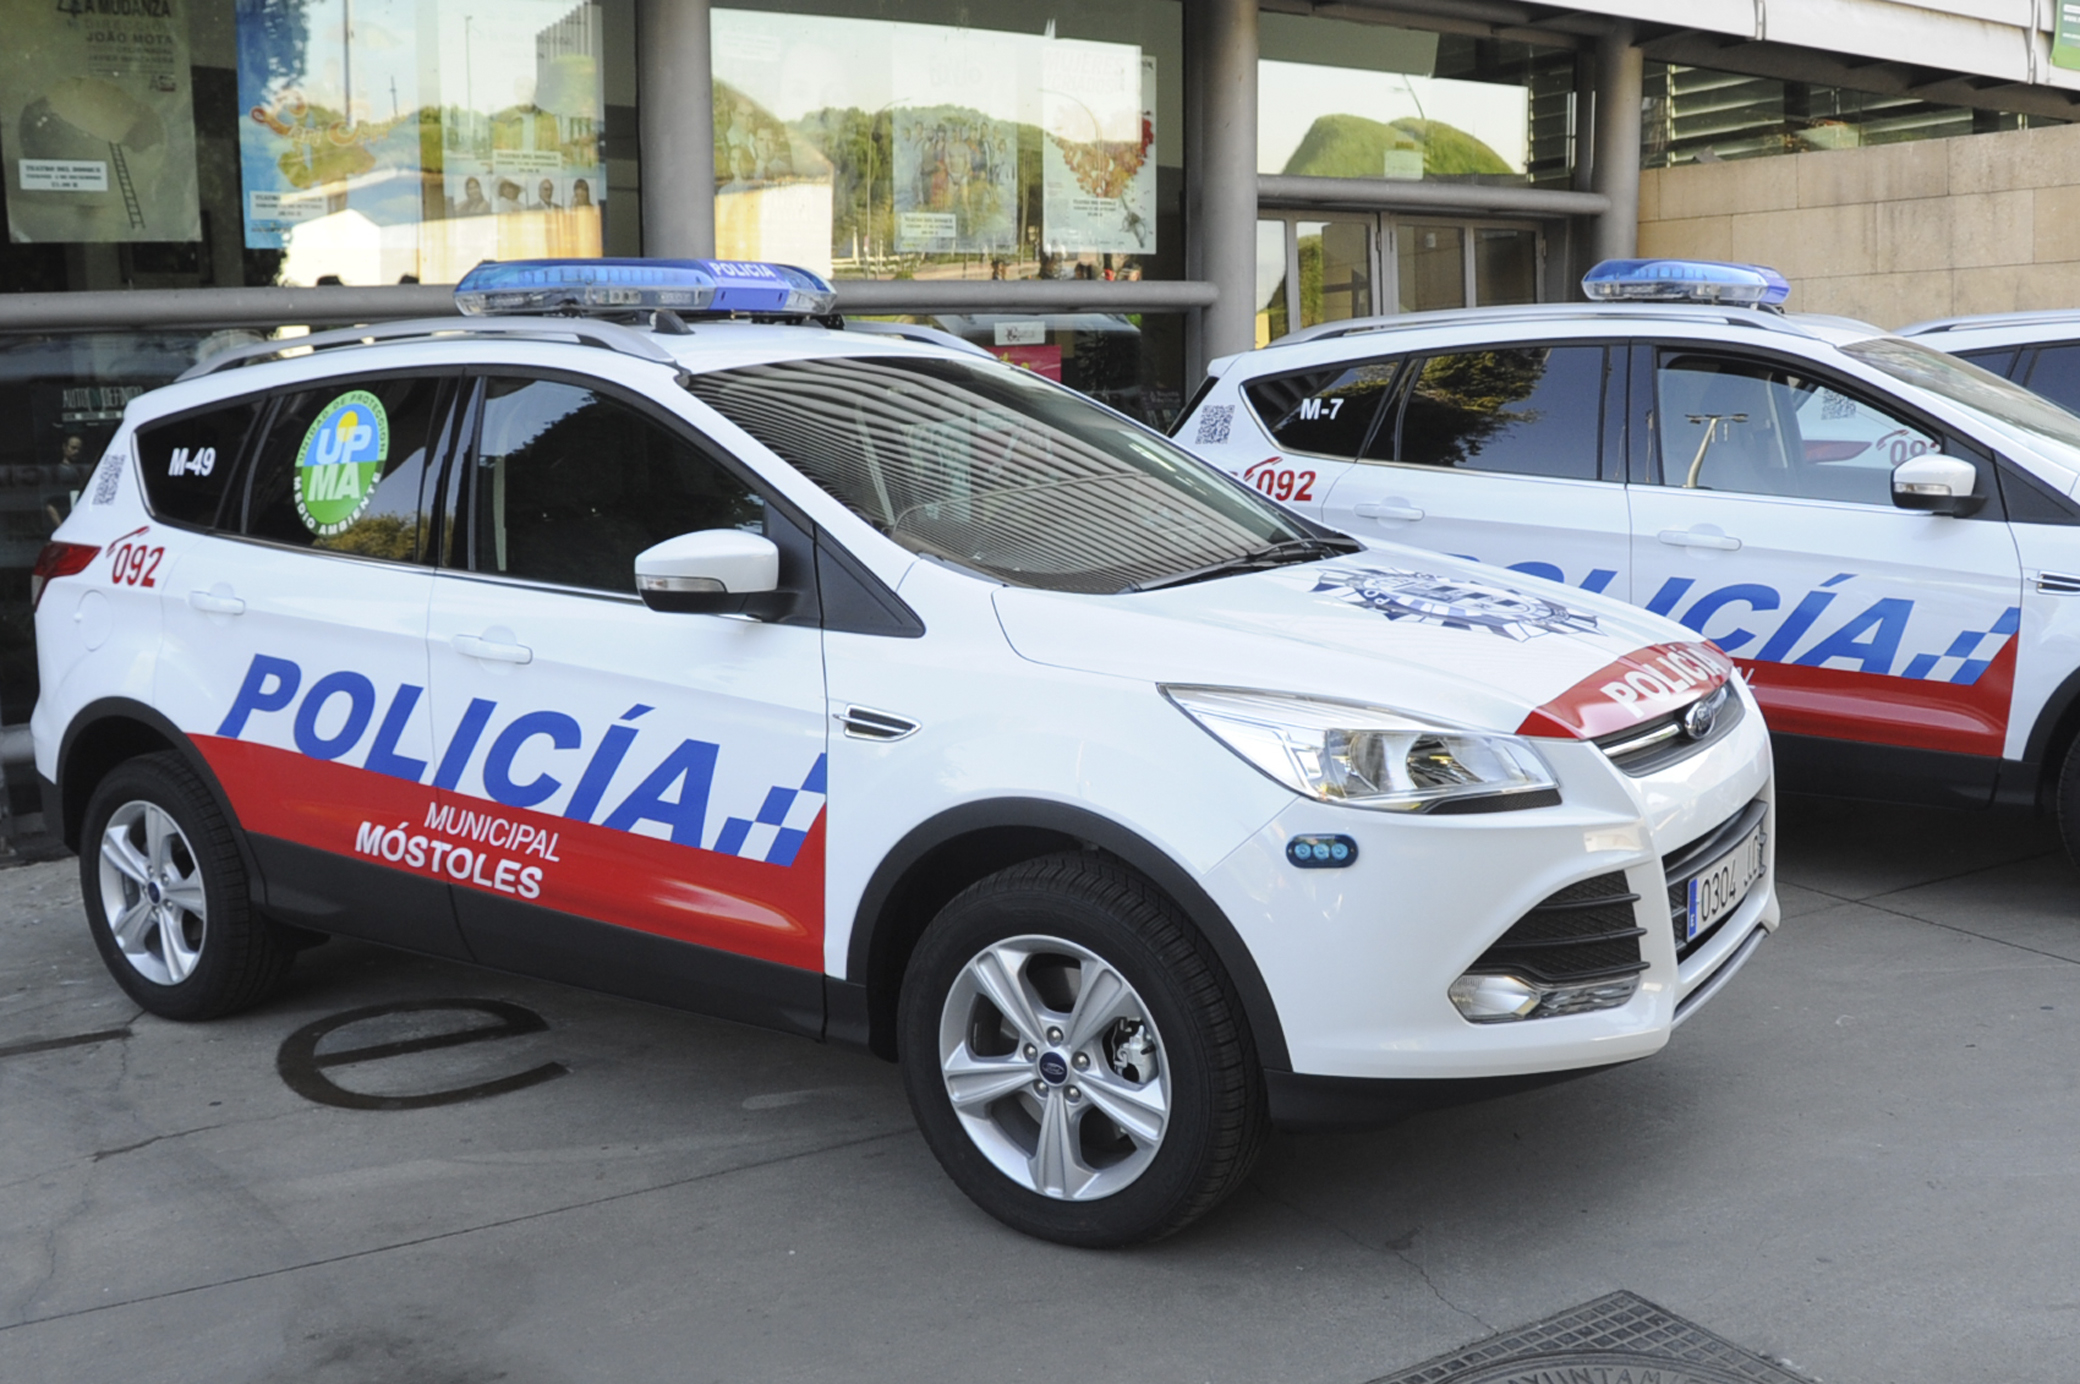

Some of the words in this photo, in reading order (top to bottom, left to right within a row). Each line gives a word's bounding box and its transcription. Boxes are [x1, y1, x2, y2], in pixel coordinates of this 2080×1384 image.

[133, 34, 174, 45] MOTA
[1300, 398, 1344, 420] M-7
[168, 447, 216, 477] M-49
[316, 424, 372, 464] UP
[1889, 440, 1938, 467] 09
[294, 475, 316, 529] MEDIO
[318, 471, 381, 536] AMBIENTE
[307, 462, 361, 502] MA
[1256, 469, 1317, 502] 092
[112, 542, 166, 588] 092
[1599, 645, 1728, 719] POLICÍA
[215, 652, 720, 850] POLICÍA
[423, 801, 561, 863] MUNICIPAL
[354, 820, 544, 899] MÓSTOLES
[1701, 858, 1737, 922] 0304
